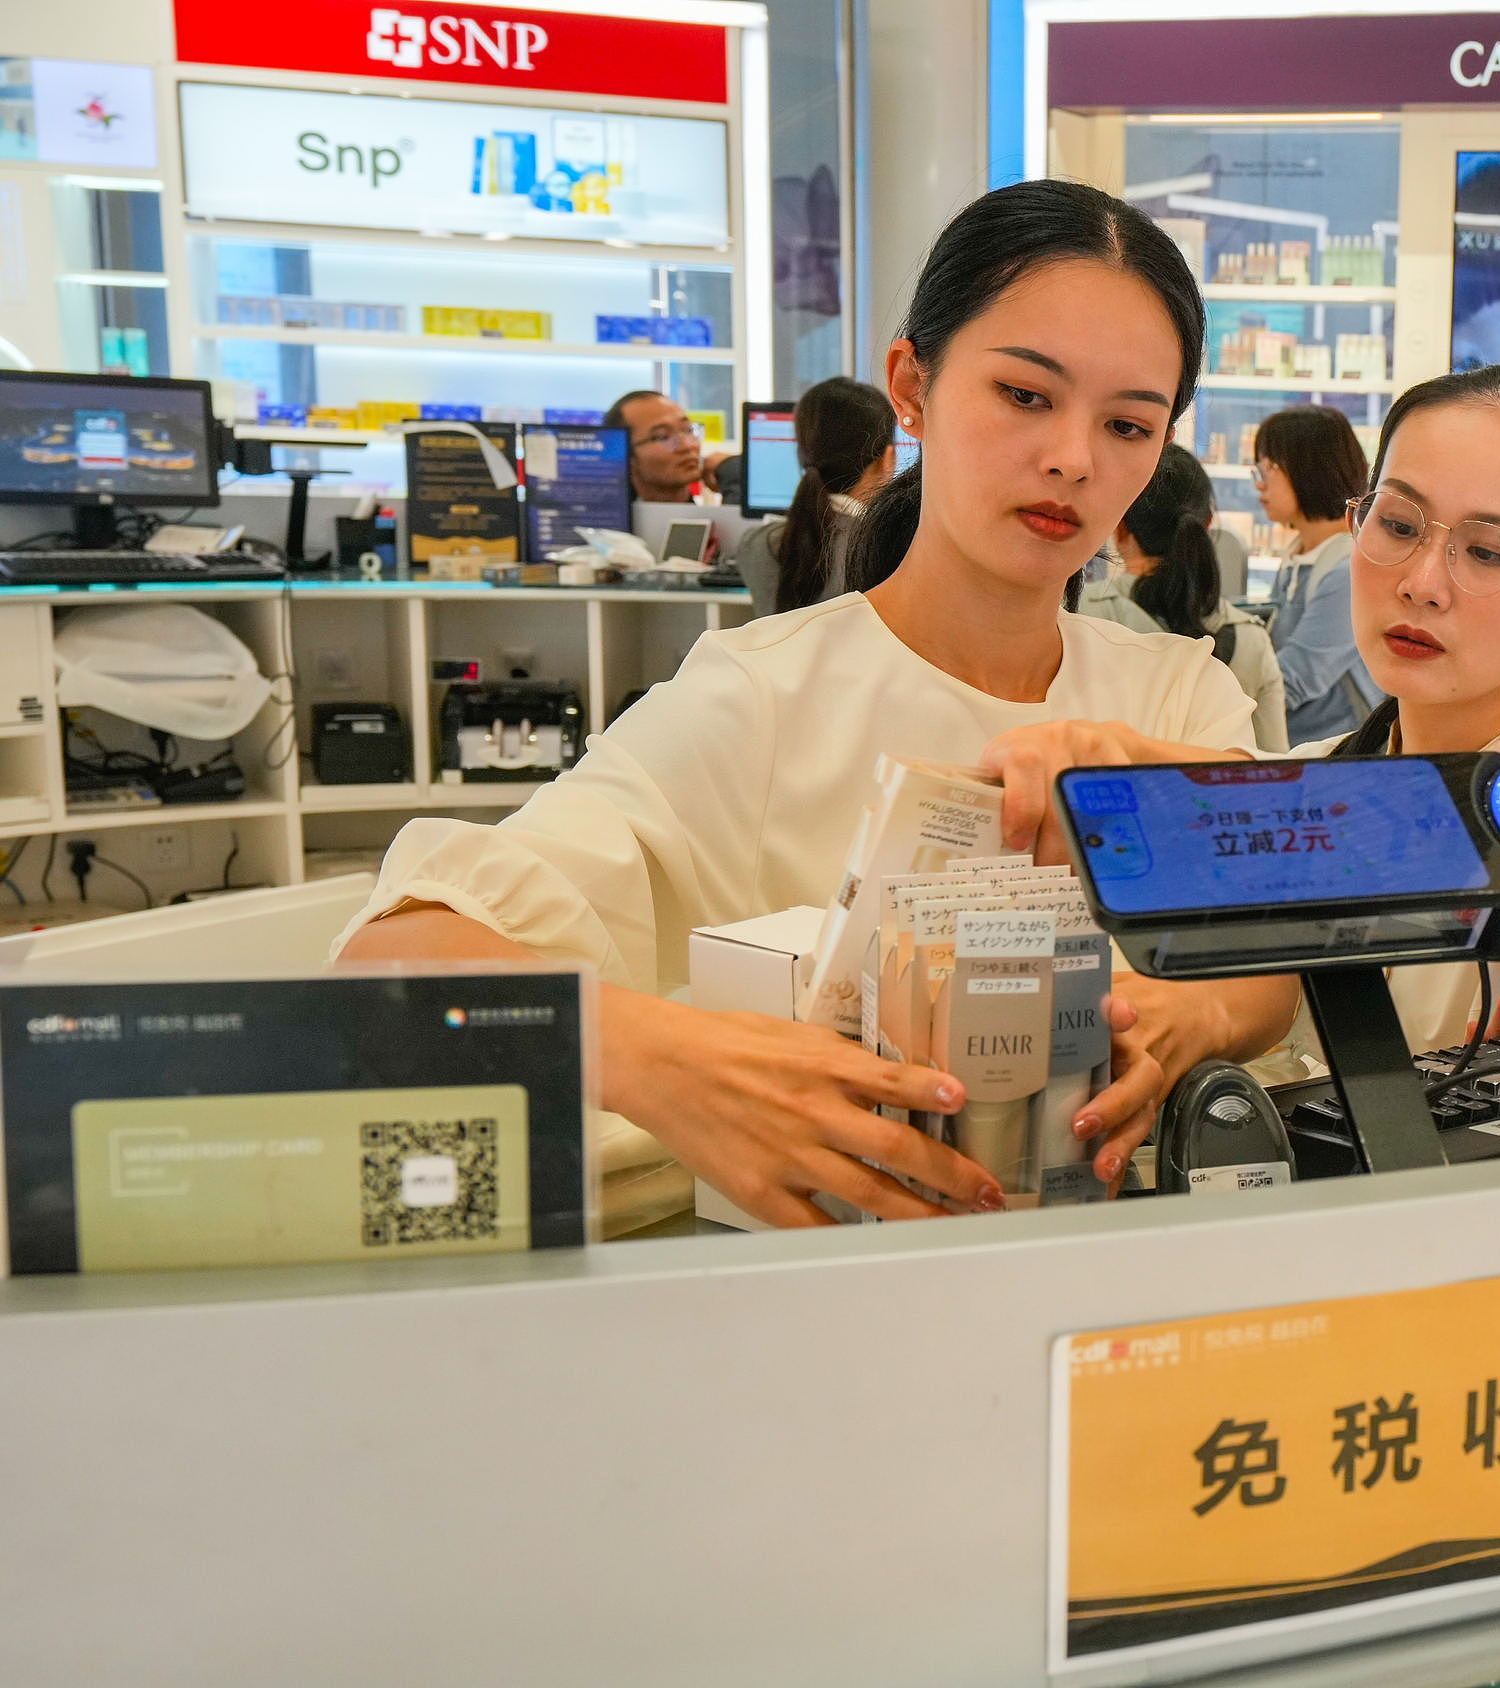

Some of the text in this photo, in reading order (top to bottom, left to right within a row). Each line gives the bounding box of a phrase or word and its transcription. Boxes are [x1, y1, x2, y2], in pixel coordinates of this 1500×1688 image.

[429, 16, 548, 71] SNP
[298, 132, 402, 188] Snp
[1211, 826, 1335, 858] 立减2元
[963, 920, 1050, 934] サンケアしながら
[966, 937, 1046, 950] エイジングケア
[967, 1034, 1033, 1057] ELIXIR
